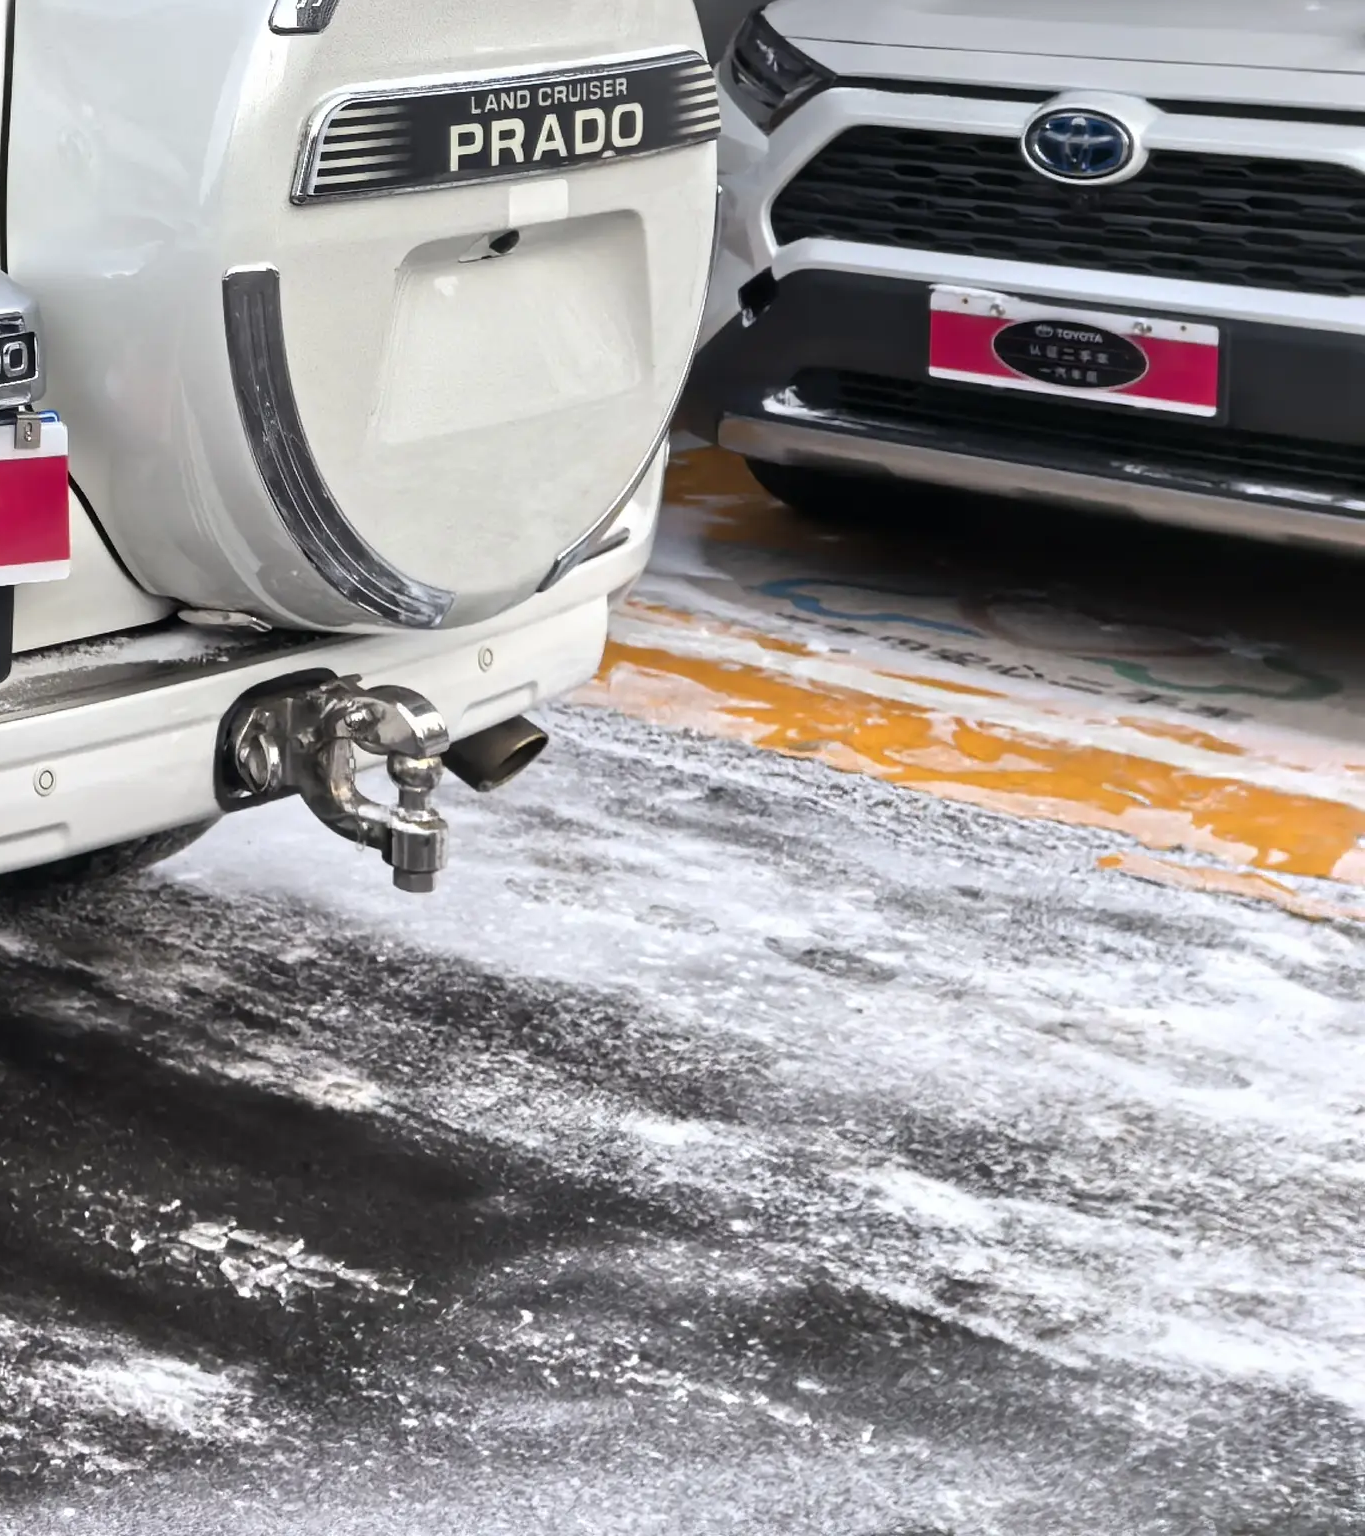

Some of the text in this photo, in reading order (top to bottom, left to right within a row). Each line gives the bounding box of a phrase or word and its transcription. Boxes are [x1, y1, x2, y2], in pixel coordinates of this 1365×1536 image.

[470, 77, 629, 115] LAND CRUISER
[449, 102, 645, 172] PRADO
[1055, 327, 1104, 344] TOYOTA
